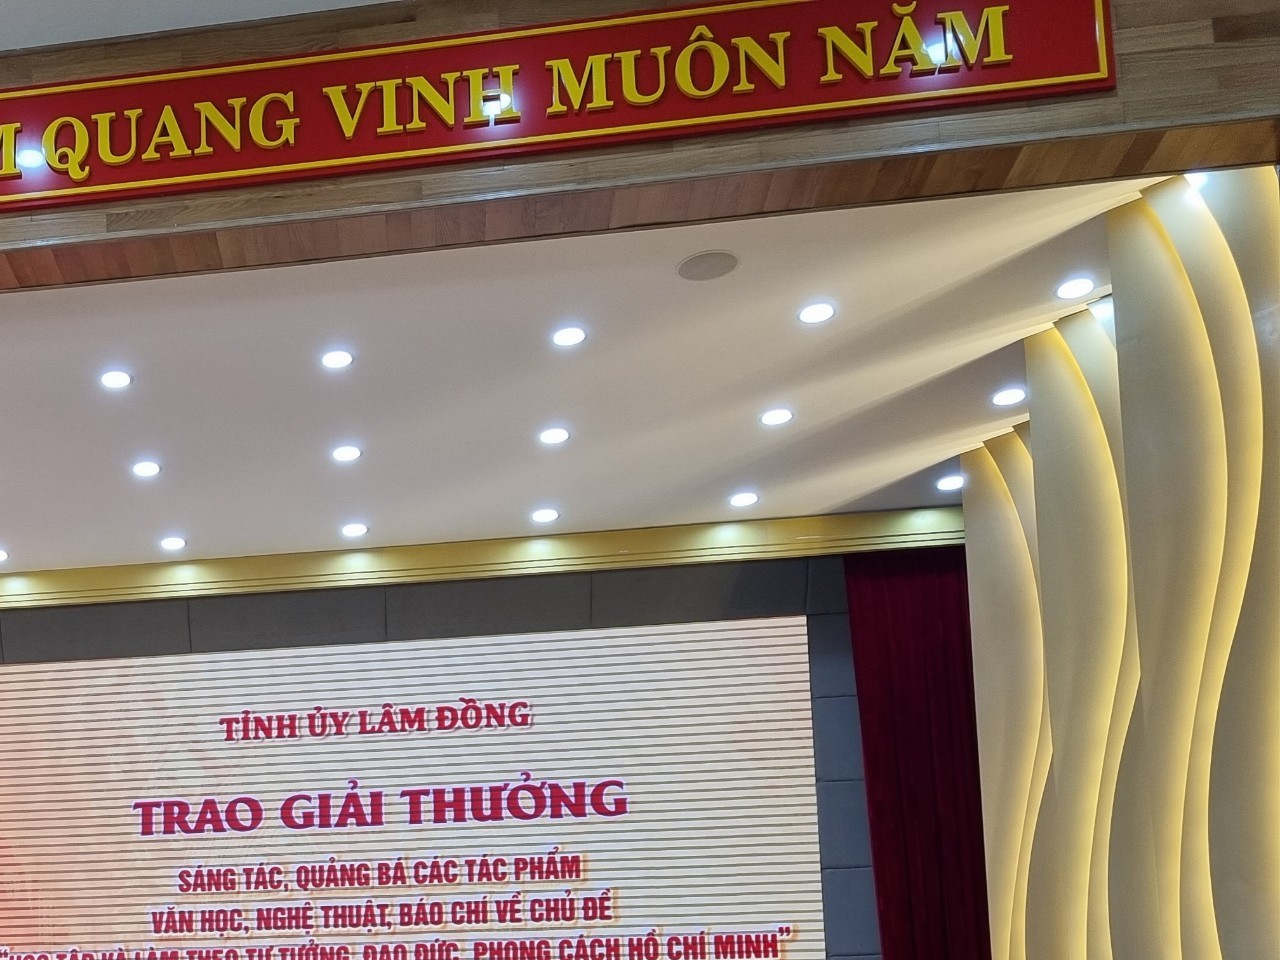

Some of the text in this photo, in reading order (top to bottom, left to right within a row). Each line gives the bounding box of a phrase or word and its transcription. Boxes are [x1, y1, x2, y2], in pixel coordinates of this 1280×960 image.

[41, 90, 300, 182] QUANG
[322, 64, 521, 141] VINH
[545, 25, 792, 117] MUÔN
[818, 1, 1013, 84] NĂM
[219, 697, 531, 741] TỈNH ỦY LÂM ĐỒNG
[132, 770, 628, 836] TRAO GIẢI THƯỞNG
[178, 846, 581, 893] SÁNG TÁC, QUẢNG BÁ CÁC TÁC PHẨM
[151, 887, 613, 938] VĂN HỌC, NGHỆ THUẬT, BÁO CHÍ VỀ CHỦ ĐỀ
[666, 930, 707, 960] CHÍ
